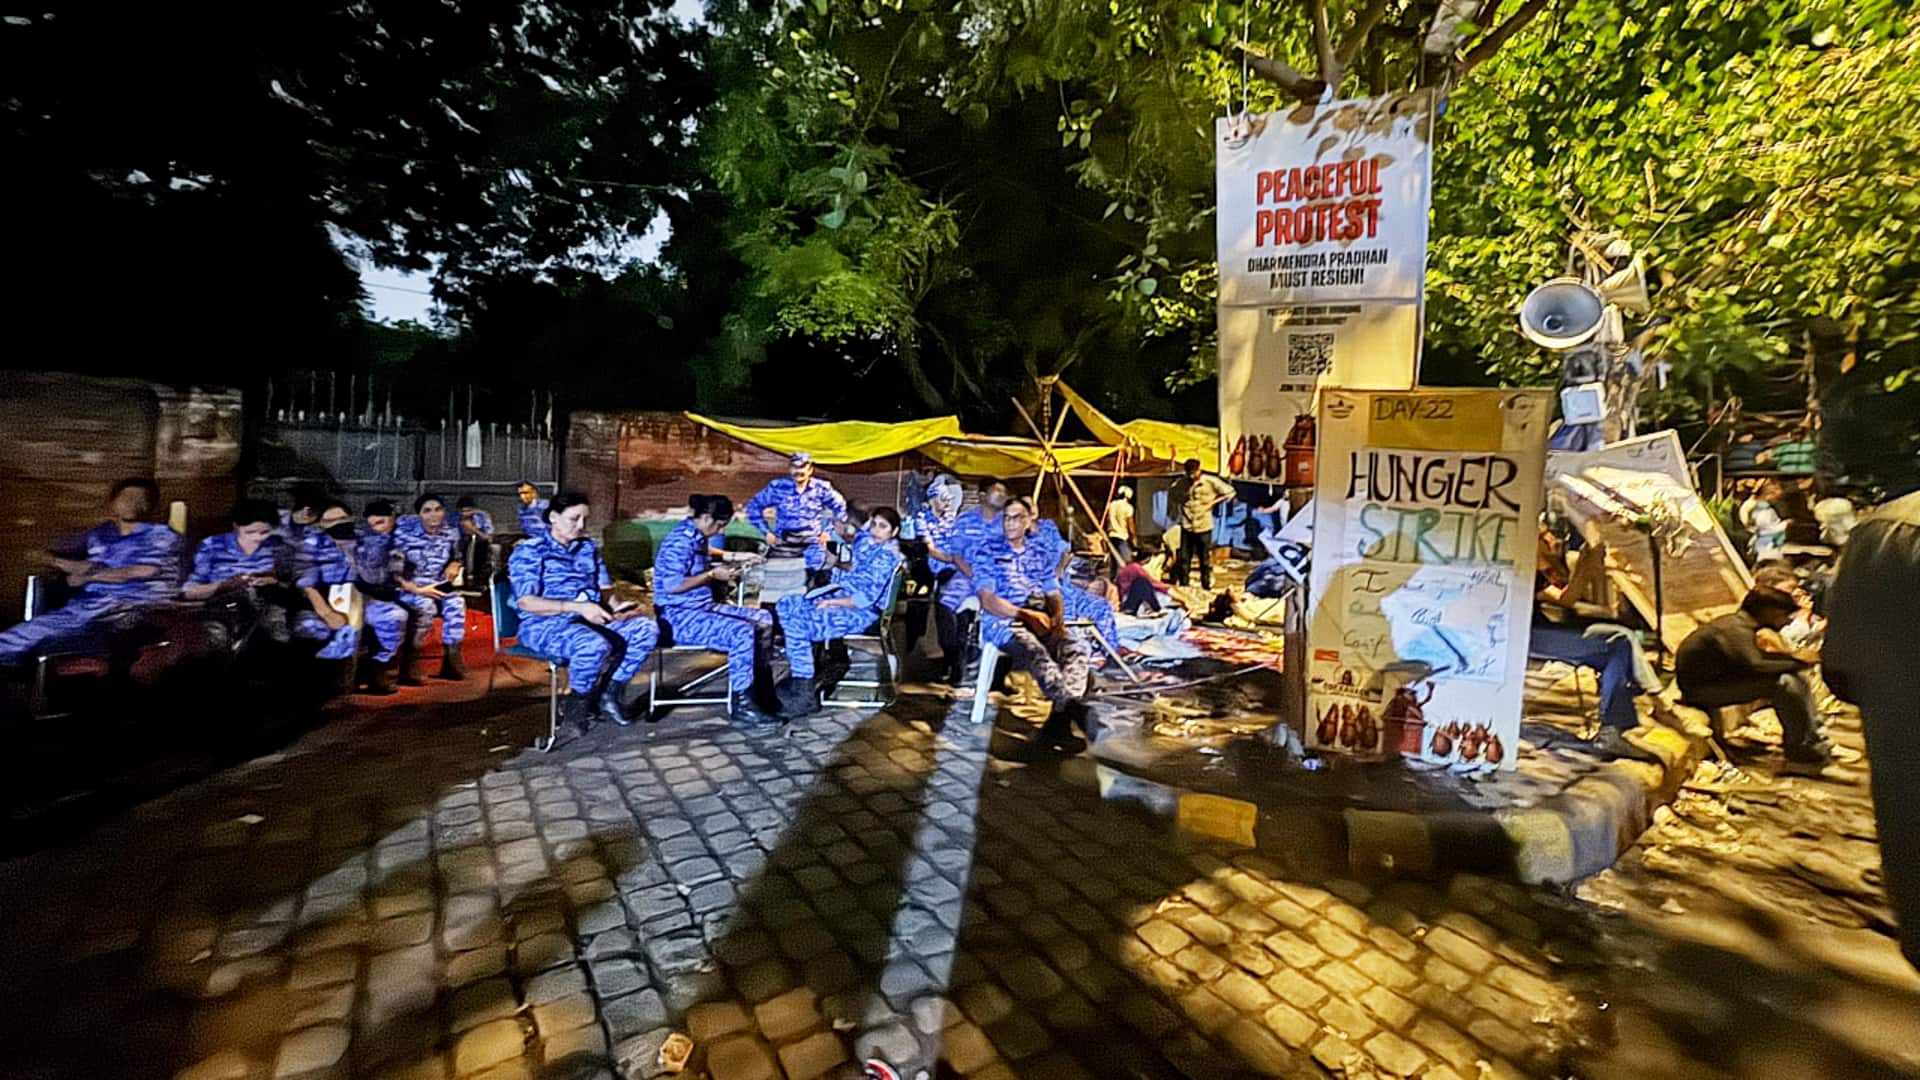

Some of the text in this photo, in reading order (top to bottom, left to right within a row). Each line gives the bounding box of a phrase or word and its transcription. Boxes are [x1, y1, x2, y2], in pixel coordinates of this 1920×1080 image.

[1257, 159, 1383, 205] PEACEFUL
[1256, 199, 1383, 247] PROTEST
[1248, 248, 1388, 272] DHARMENDRA PRADHAN
[1270, 268, 1365, 289] MUST RESIGN!
[1346, 451, 1521, 512] HUNGER
[1358, 503, 1516, 565] STRIKE
[1352, 569, 1389, 593] I
